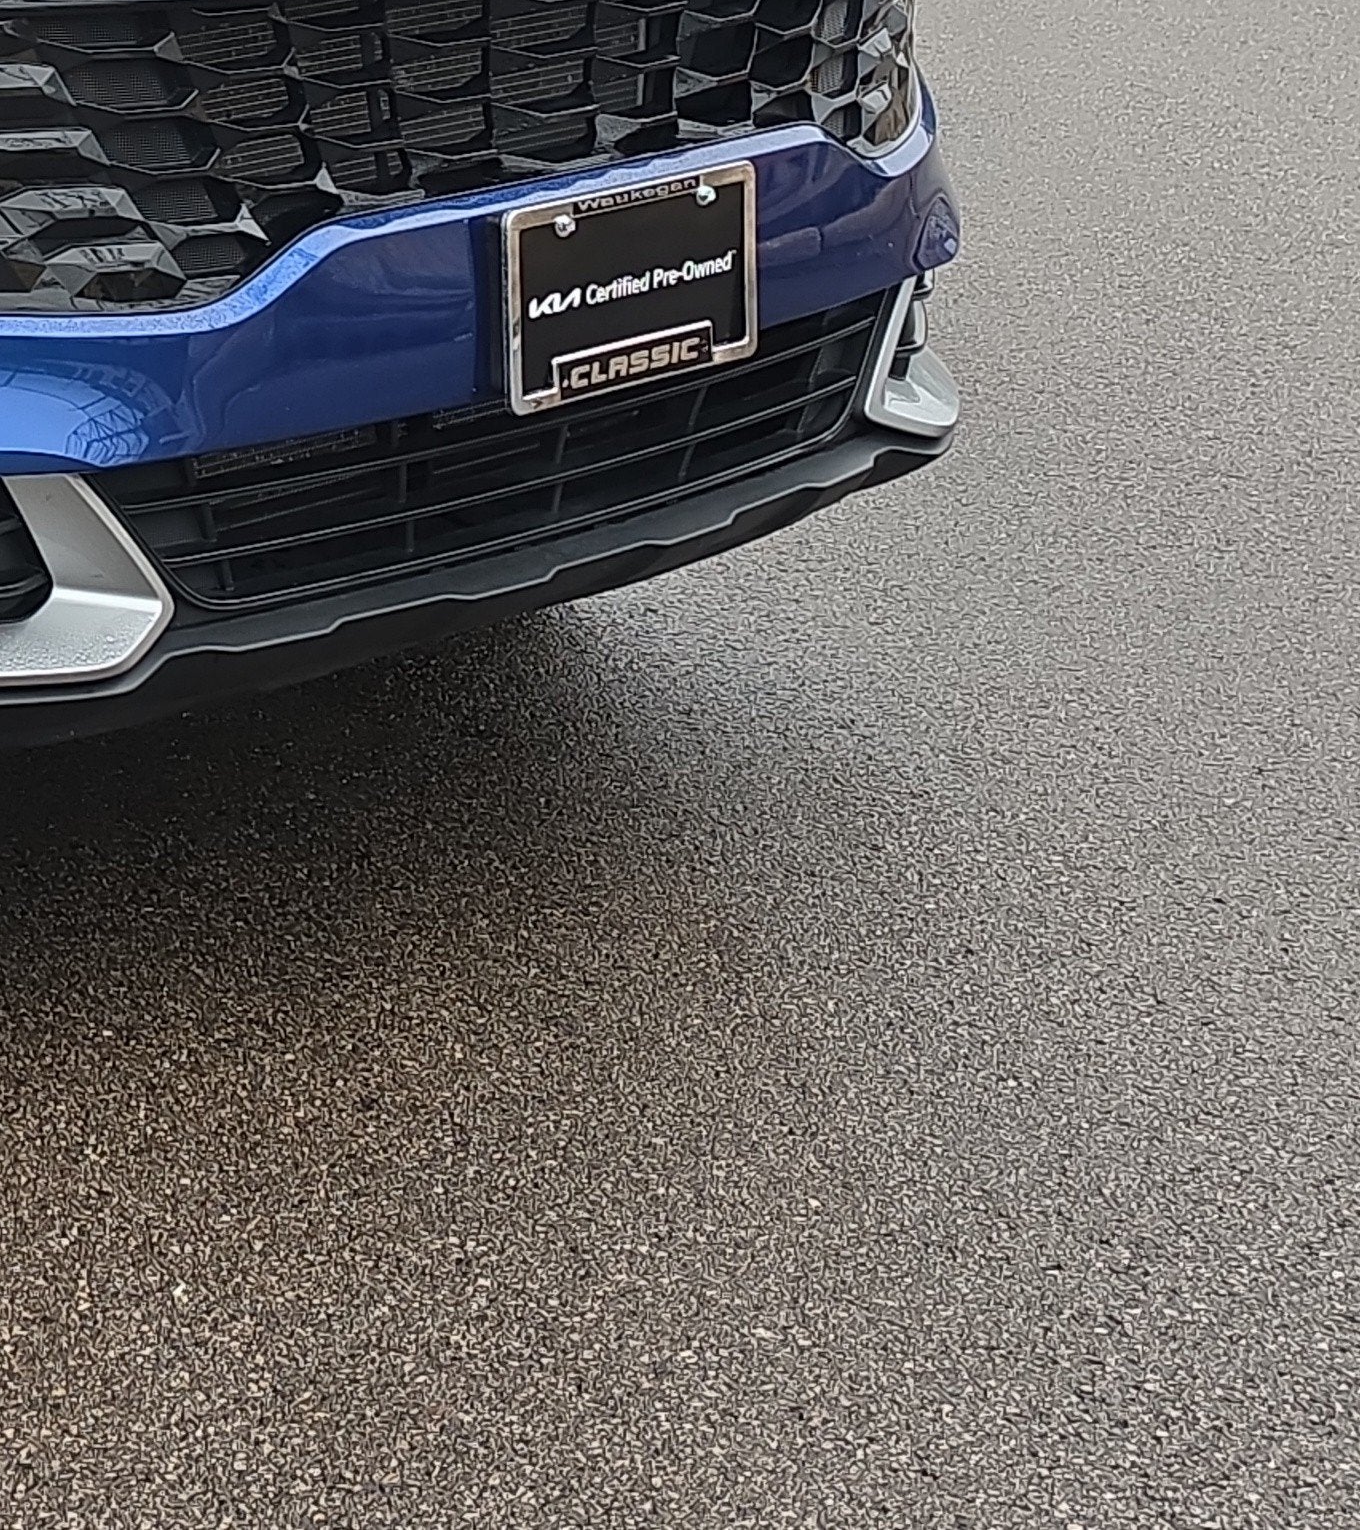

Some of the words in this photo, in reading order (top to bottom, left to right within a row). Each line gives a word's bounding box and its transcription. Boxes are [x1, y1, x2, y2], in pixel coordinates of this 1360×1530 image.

[578, 178, 697, 211] Waukegan
[529, 287, 581, 318] KIA
[585, 271, 650, 304] Certified
[652, 251, 733, 288] Pre-Owned
[570, 337, 701, 389] CLASSIC
